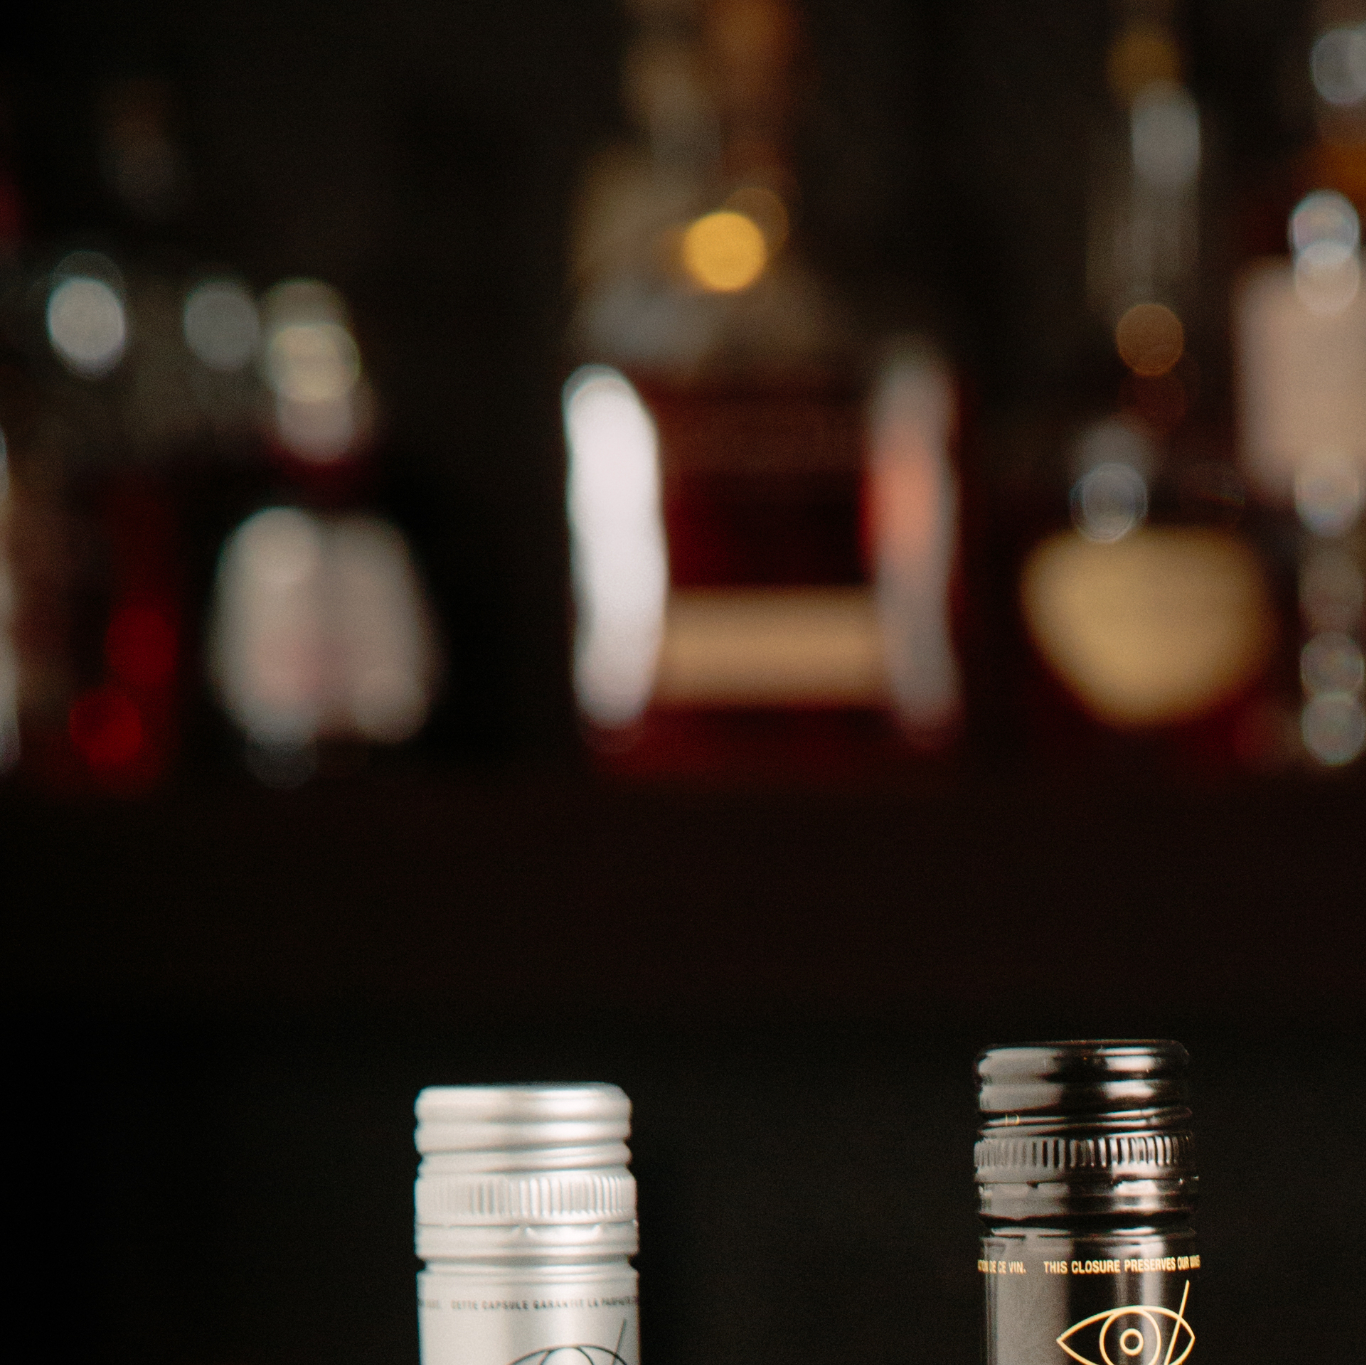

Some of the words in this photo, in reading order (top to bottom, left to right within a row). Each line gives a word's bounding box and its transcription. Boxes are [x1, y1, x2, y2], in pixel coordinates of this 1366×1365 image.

[1008, 1260, 1027, 1275] VIN.
[1044, 1260, 1068, 1274] THIS
[1071, 1259, 1121, 1274] CLOSURE
[1124, 1257, 1176, 1273] PRESERVES
